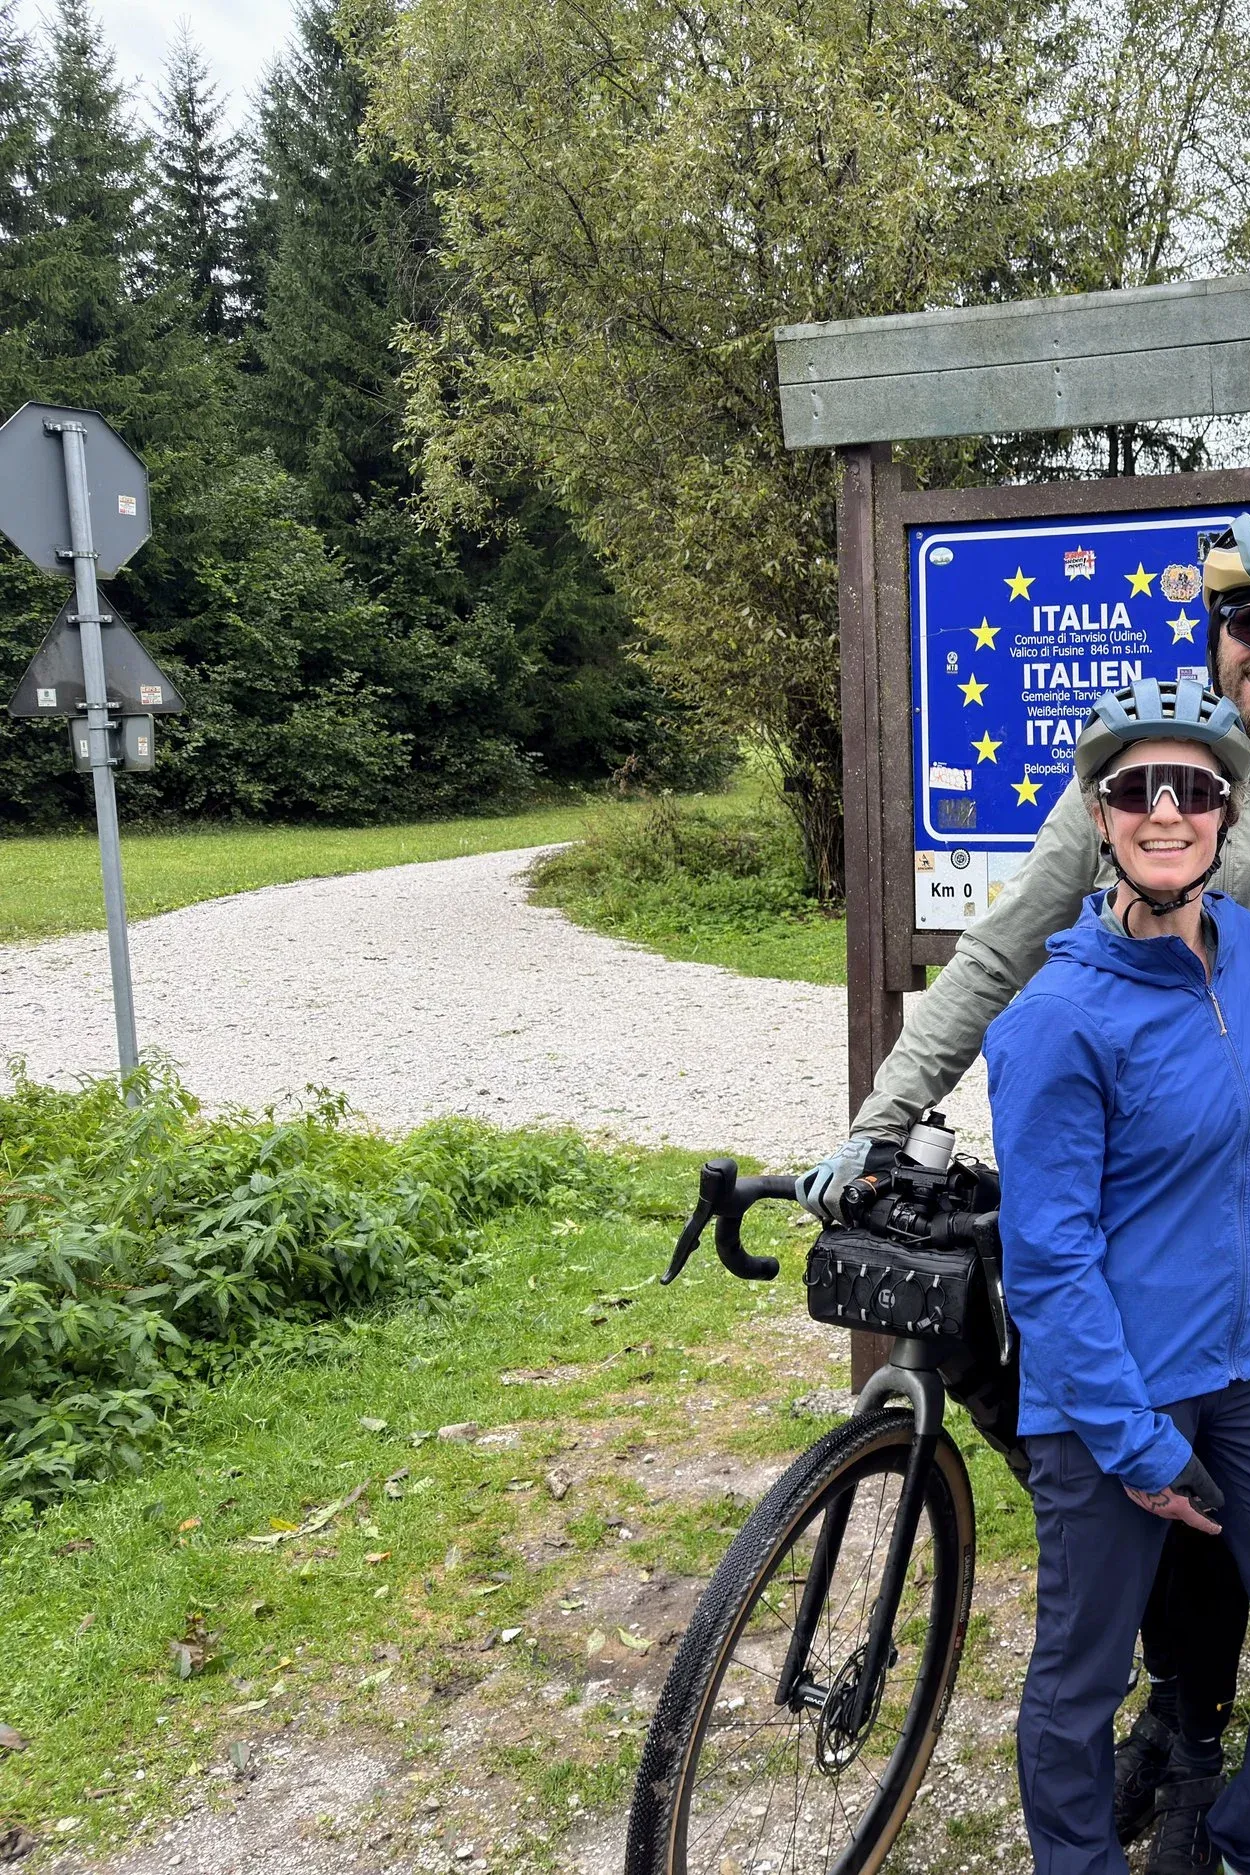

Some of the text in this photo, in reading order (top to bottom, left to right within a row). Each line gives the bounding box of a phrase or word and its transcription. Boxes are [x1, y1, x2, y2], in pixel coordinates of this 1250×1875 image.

[1033, 602, 1132, 632] ITALIA
[1014, 629, 1147, 646] Comune di Tarvisio (Udine)
[1009, 642, 1153, 658] Valico di Fusine 846 m s.l.m.
[1023, 660, 1142, 690] ITALIEN
[1021, 689, 1070, 702] Gemeinde
[1072, 689, 1101, 701] Tarvis
[1027, 705, 1092, 718] Weißenfelspa
[1024, 762, 1070, 776] Belopeški
[931, 882, 973, 898] Km 0
